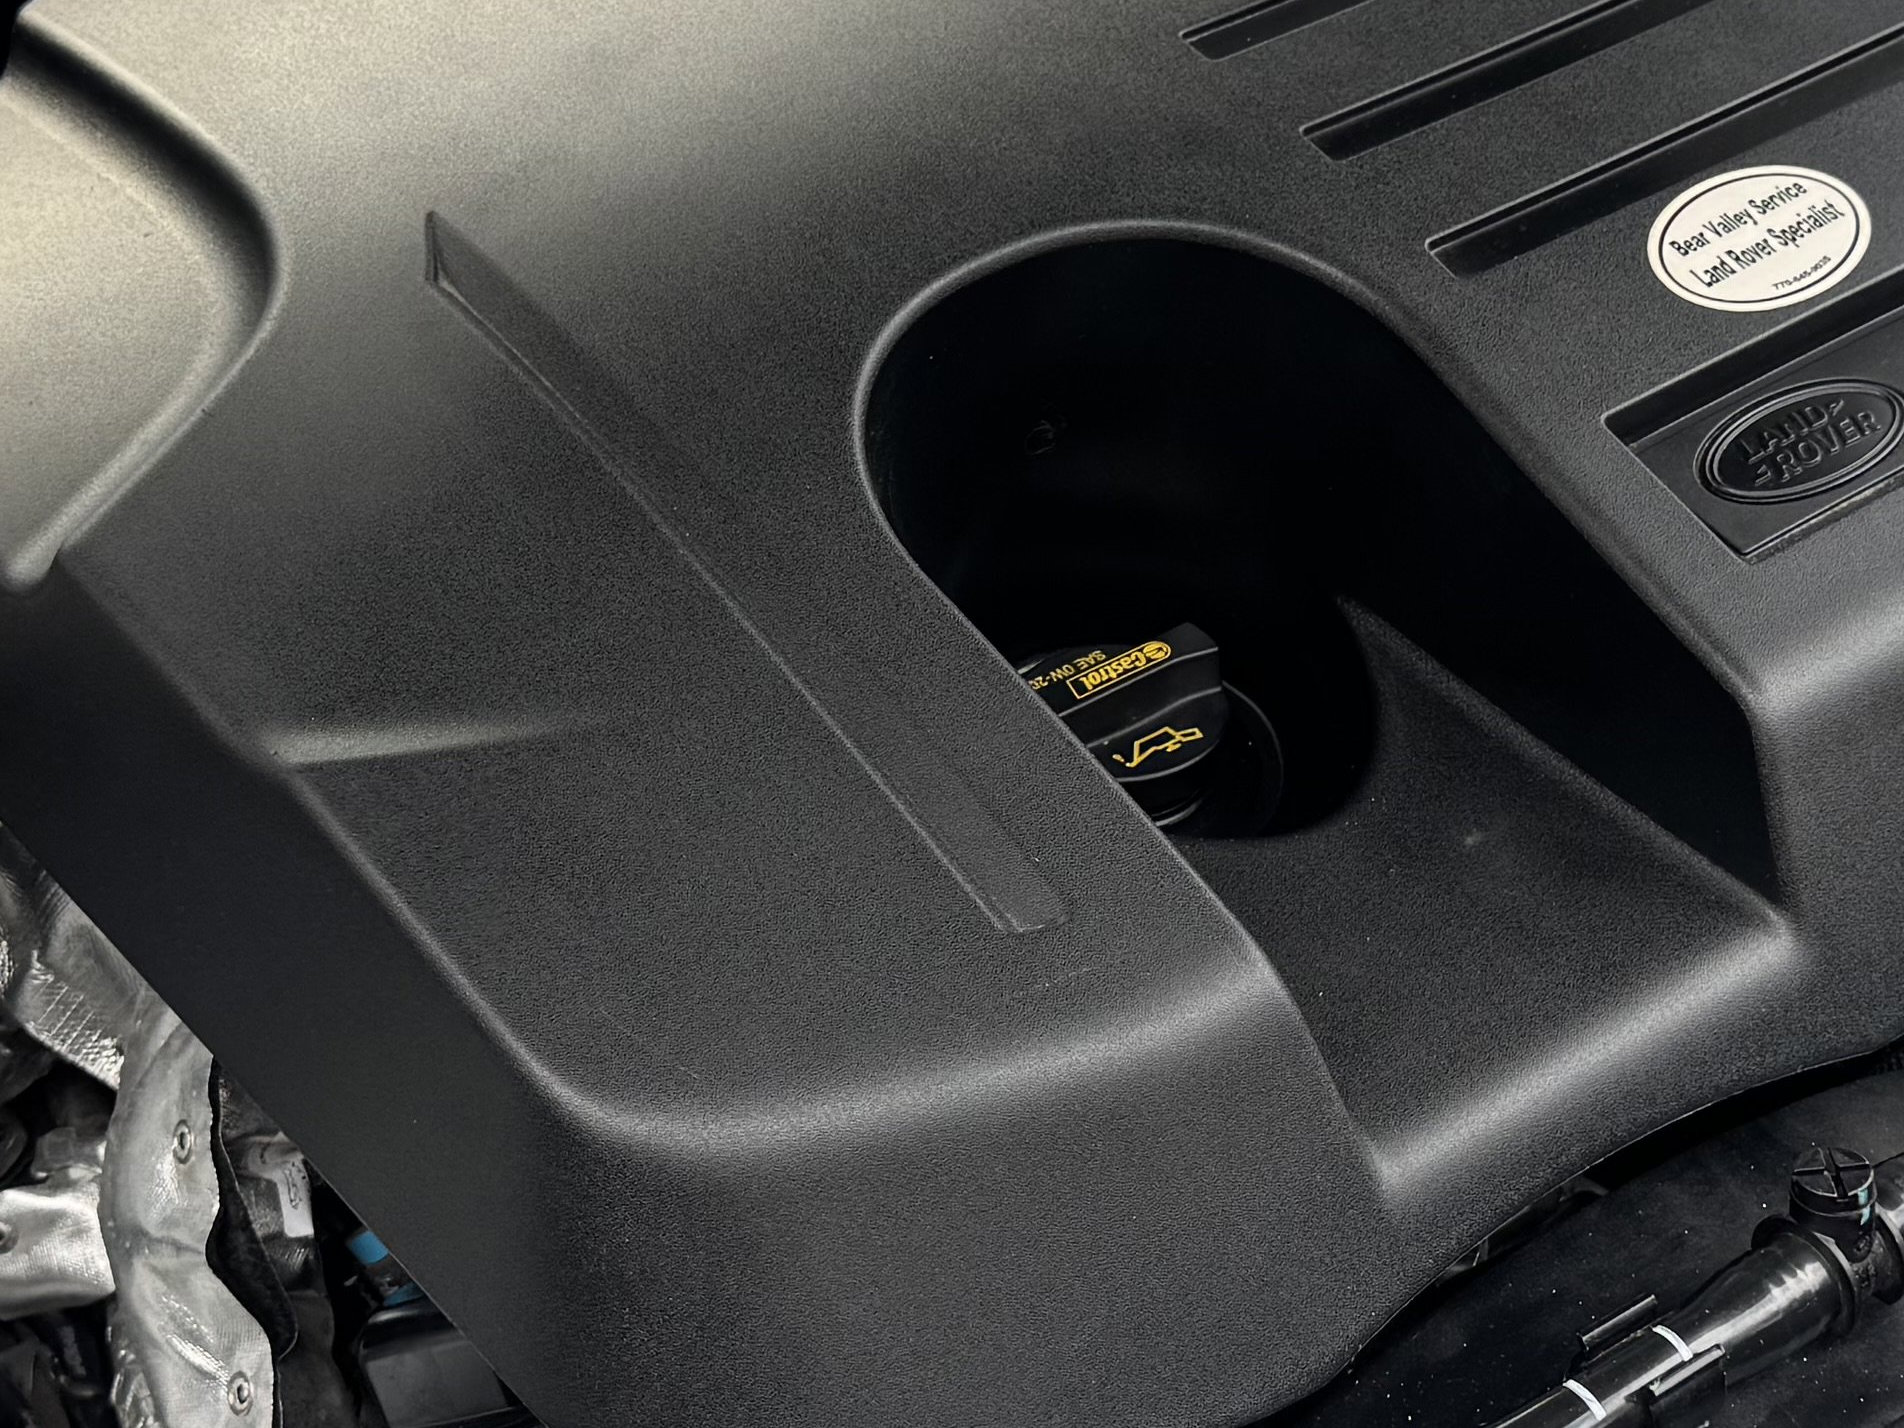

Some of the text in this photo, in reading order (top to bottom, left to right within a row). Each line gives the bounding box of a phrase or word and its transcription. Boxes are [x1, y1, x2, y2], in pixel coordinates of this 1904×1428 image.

[1668, 182, 1807, 257] Bear Valley Service
[1689, 199, 1845, 287] Land Rover Specialist
[1739, 401, 1829, 463] LAND
[1778, 409, 1882, 482] ROVER
[1075, 650, 1107, 670] SAE
[1079, 652, 1147, 691] Castrol
